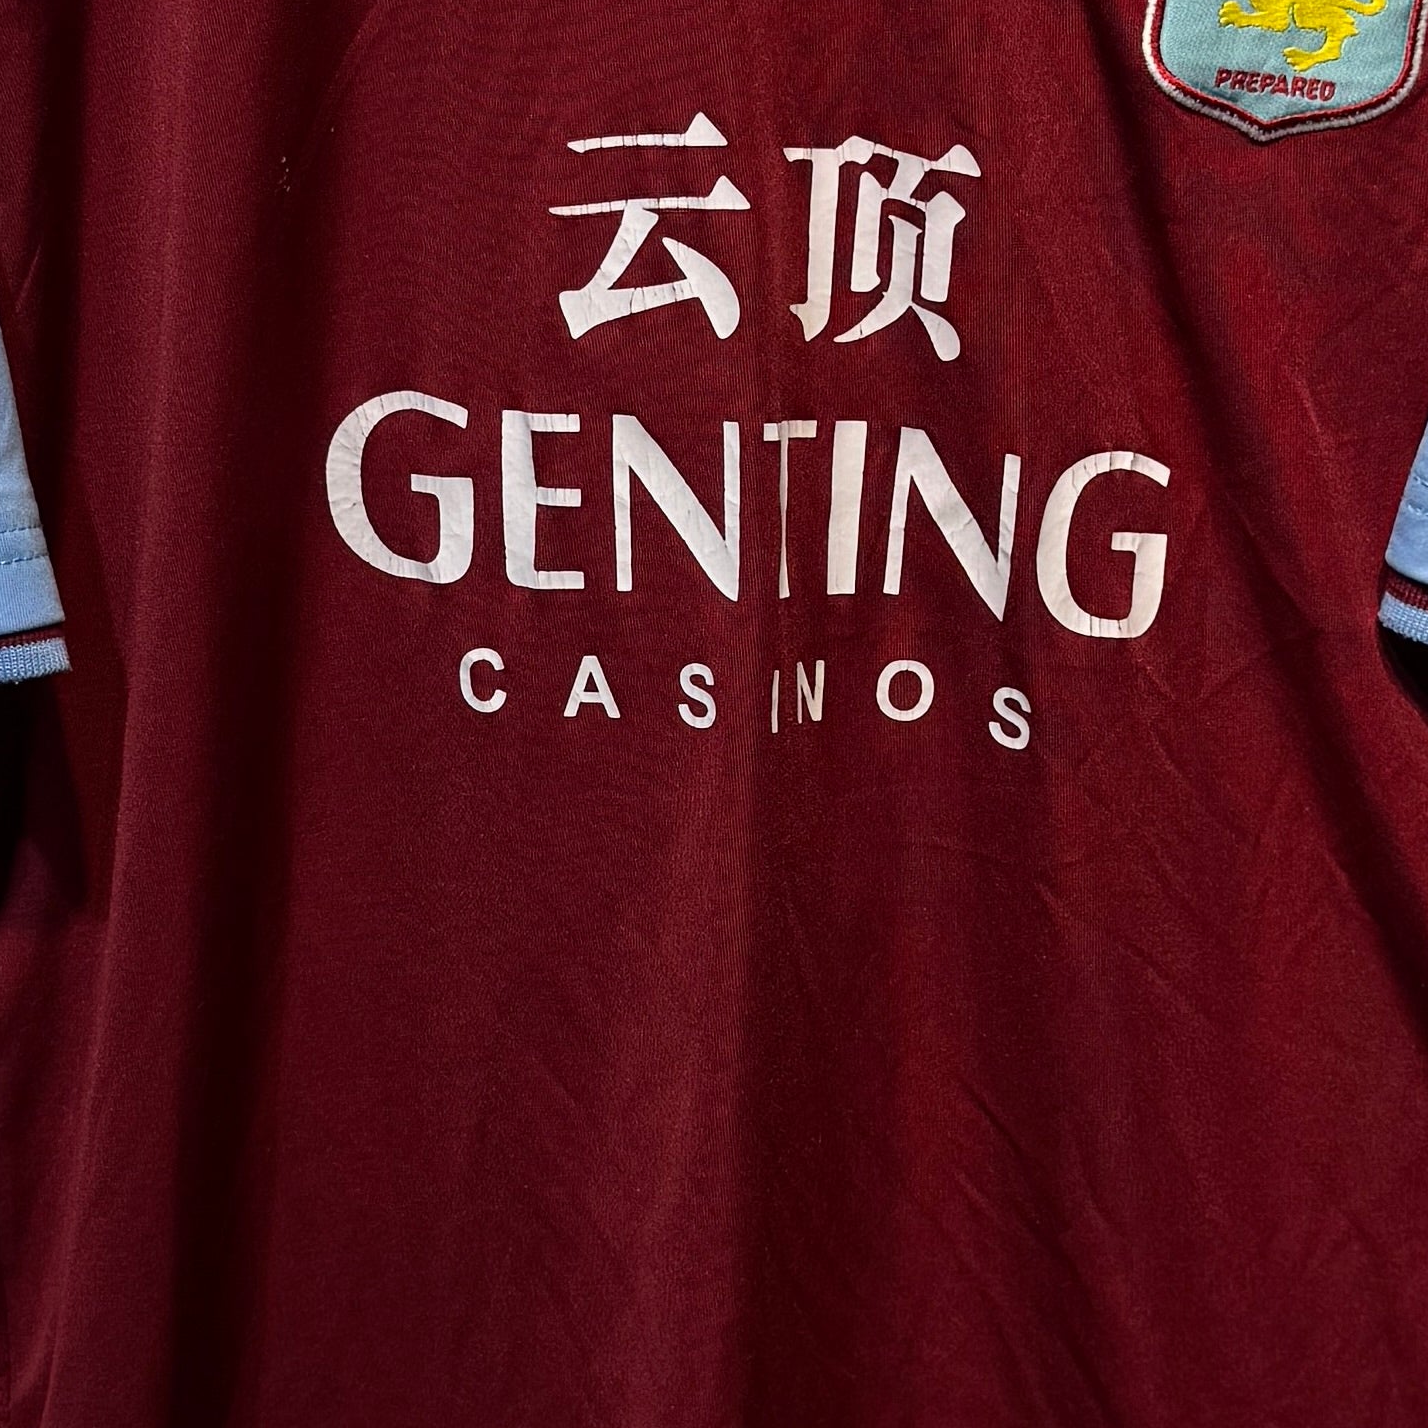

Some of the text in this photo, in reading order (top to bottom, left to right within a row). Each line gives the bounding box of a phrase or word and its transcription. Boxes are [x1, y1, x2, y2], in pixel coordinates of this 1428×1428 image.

[1213, 69, 1337, 102] PREPARED
[548, 111, 982, 362] 云顶
[325, 390, 1171, 639] GENTING
[459, 647, 1032, 750] CASINOS
